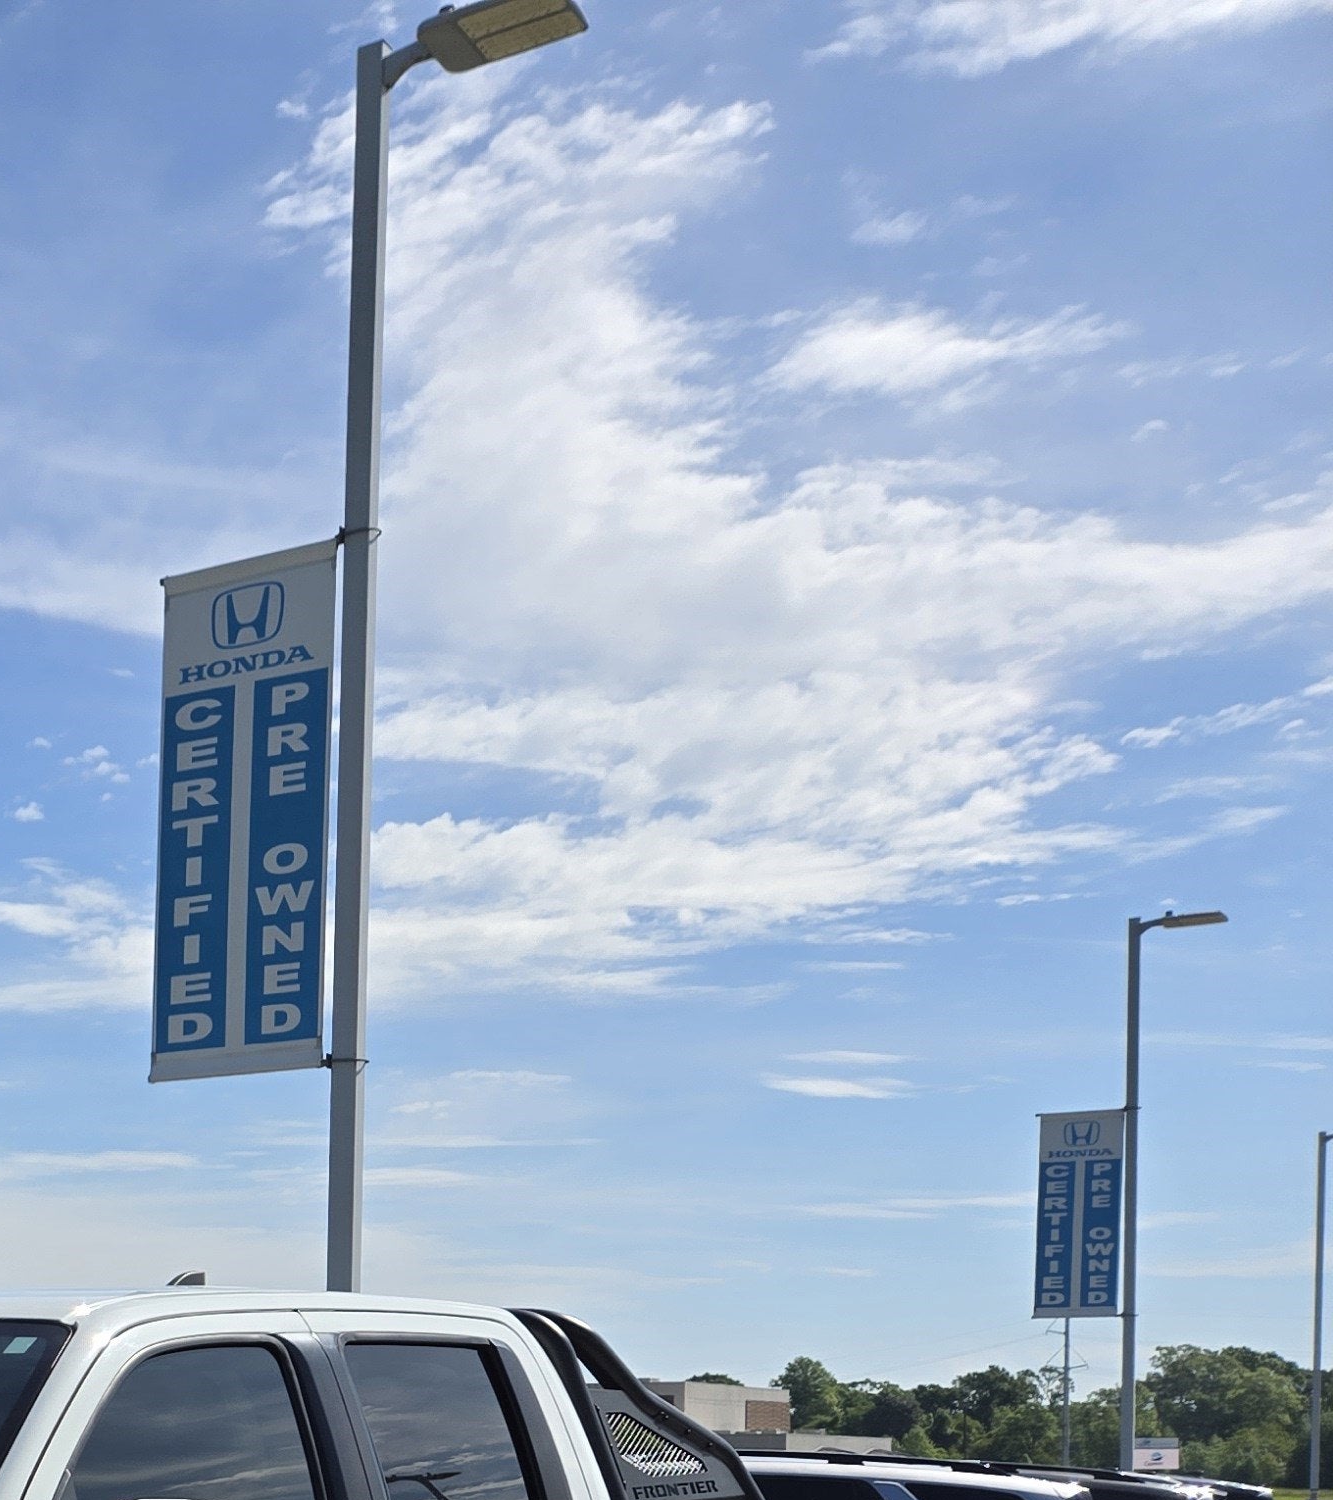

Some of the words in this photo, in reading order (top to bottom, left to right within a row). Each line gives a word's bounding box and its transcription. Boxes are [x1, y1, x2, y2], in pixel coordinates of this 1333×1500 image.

[178, 644, 314, 686] HONDA
[267, 681, 310, 797] PRE
[167, 698, 223, 1045] CERTIFIED
[254, 841, 314, 1035] OWNED
[1048, 1148, 1113, 1159] HONDA
[1091, 1162, 1112, 1209] PRE
[1041, 1164, 1070, 1306] CERTIFIED
[1085, 1226, 1115, 1305] OWNED
[632, 1479, 719, 1500] FRONTIER
